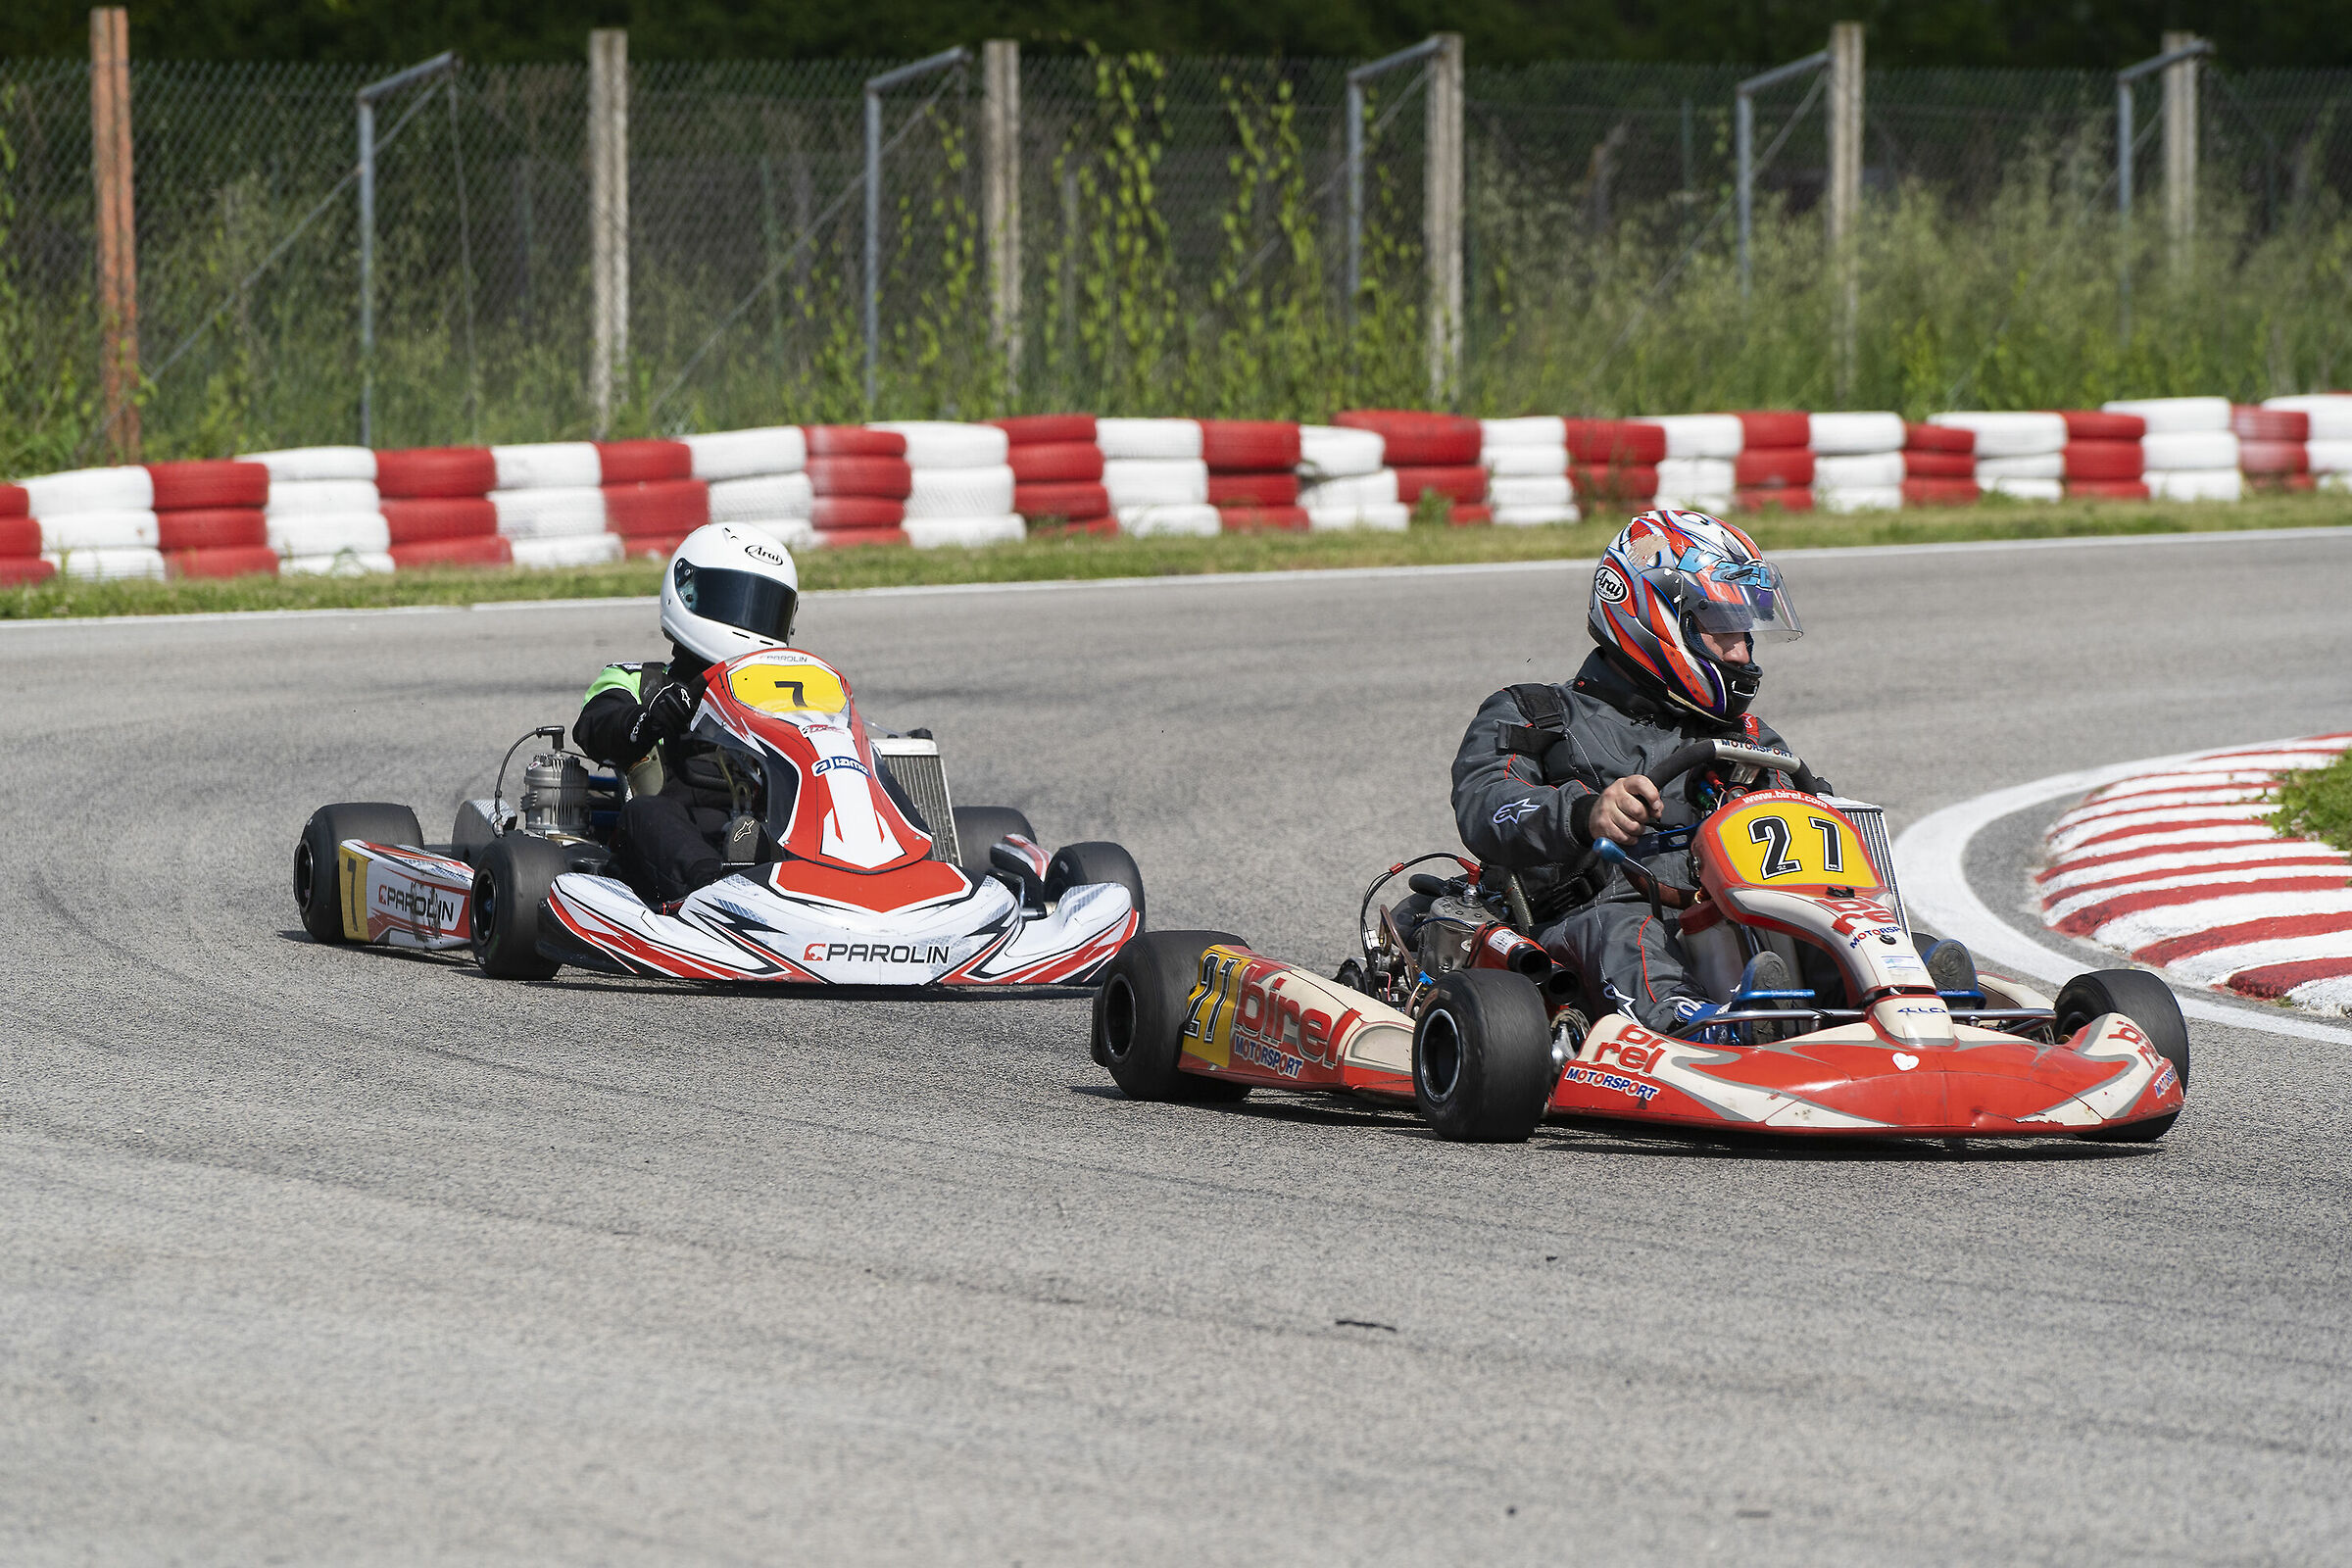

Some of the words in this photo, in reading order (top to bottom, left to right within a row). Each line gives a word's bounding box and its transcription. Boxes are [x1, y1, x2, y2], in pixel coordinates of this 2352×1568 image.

[748, 546, 781, 563] Arai
[1595, 570, 1623, 597] Arai
[774, 681, 808, 708] 7
[1742, 790, 1829, 809] www.birel.com
[1747, 815, 1843, 880] 21
[347, 857, 359, 932] 7
[1184, 953, 1241, 1044] 21
[1234, 963, 1363, 1068] birel
[1235, 1035, 1303, 1078] MOTORSPORT
[1566, 1067, 1660, 1100] MOTORSPORT
